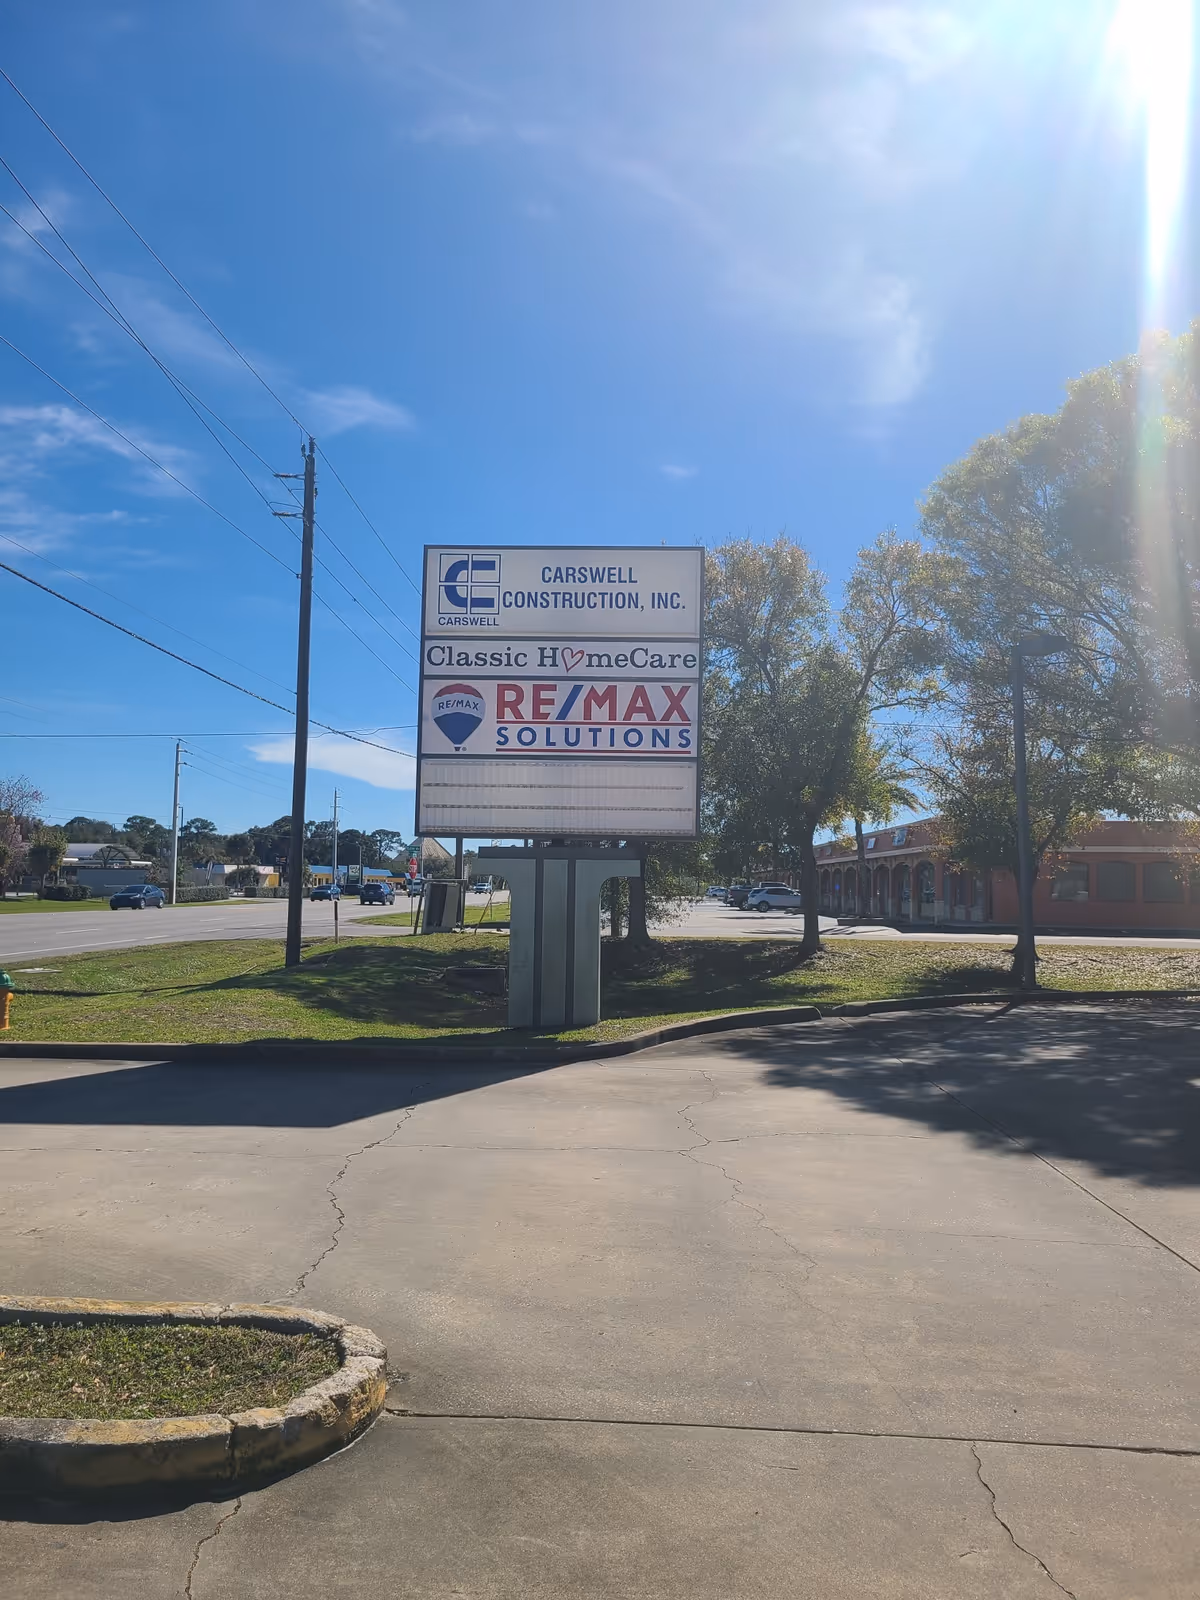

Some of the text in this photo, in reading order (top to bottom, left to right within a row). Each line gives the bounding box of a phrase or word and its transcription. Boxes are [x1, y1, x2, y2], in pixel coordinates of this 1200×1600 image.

[541, 566, 638, 584] CARSWELL
[502, 591, 686, 612] CONSTRUCTION, INC.
[438, 616, 500, 626] CARSWELL
[426, 645, 528, 667] Classic
[438, 699, 479, 711] RE/MAX
[496, 683, 692, 722] RE/MAX
[496, 726, 692, 748] SOLUTIONS
